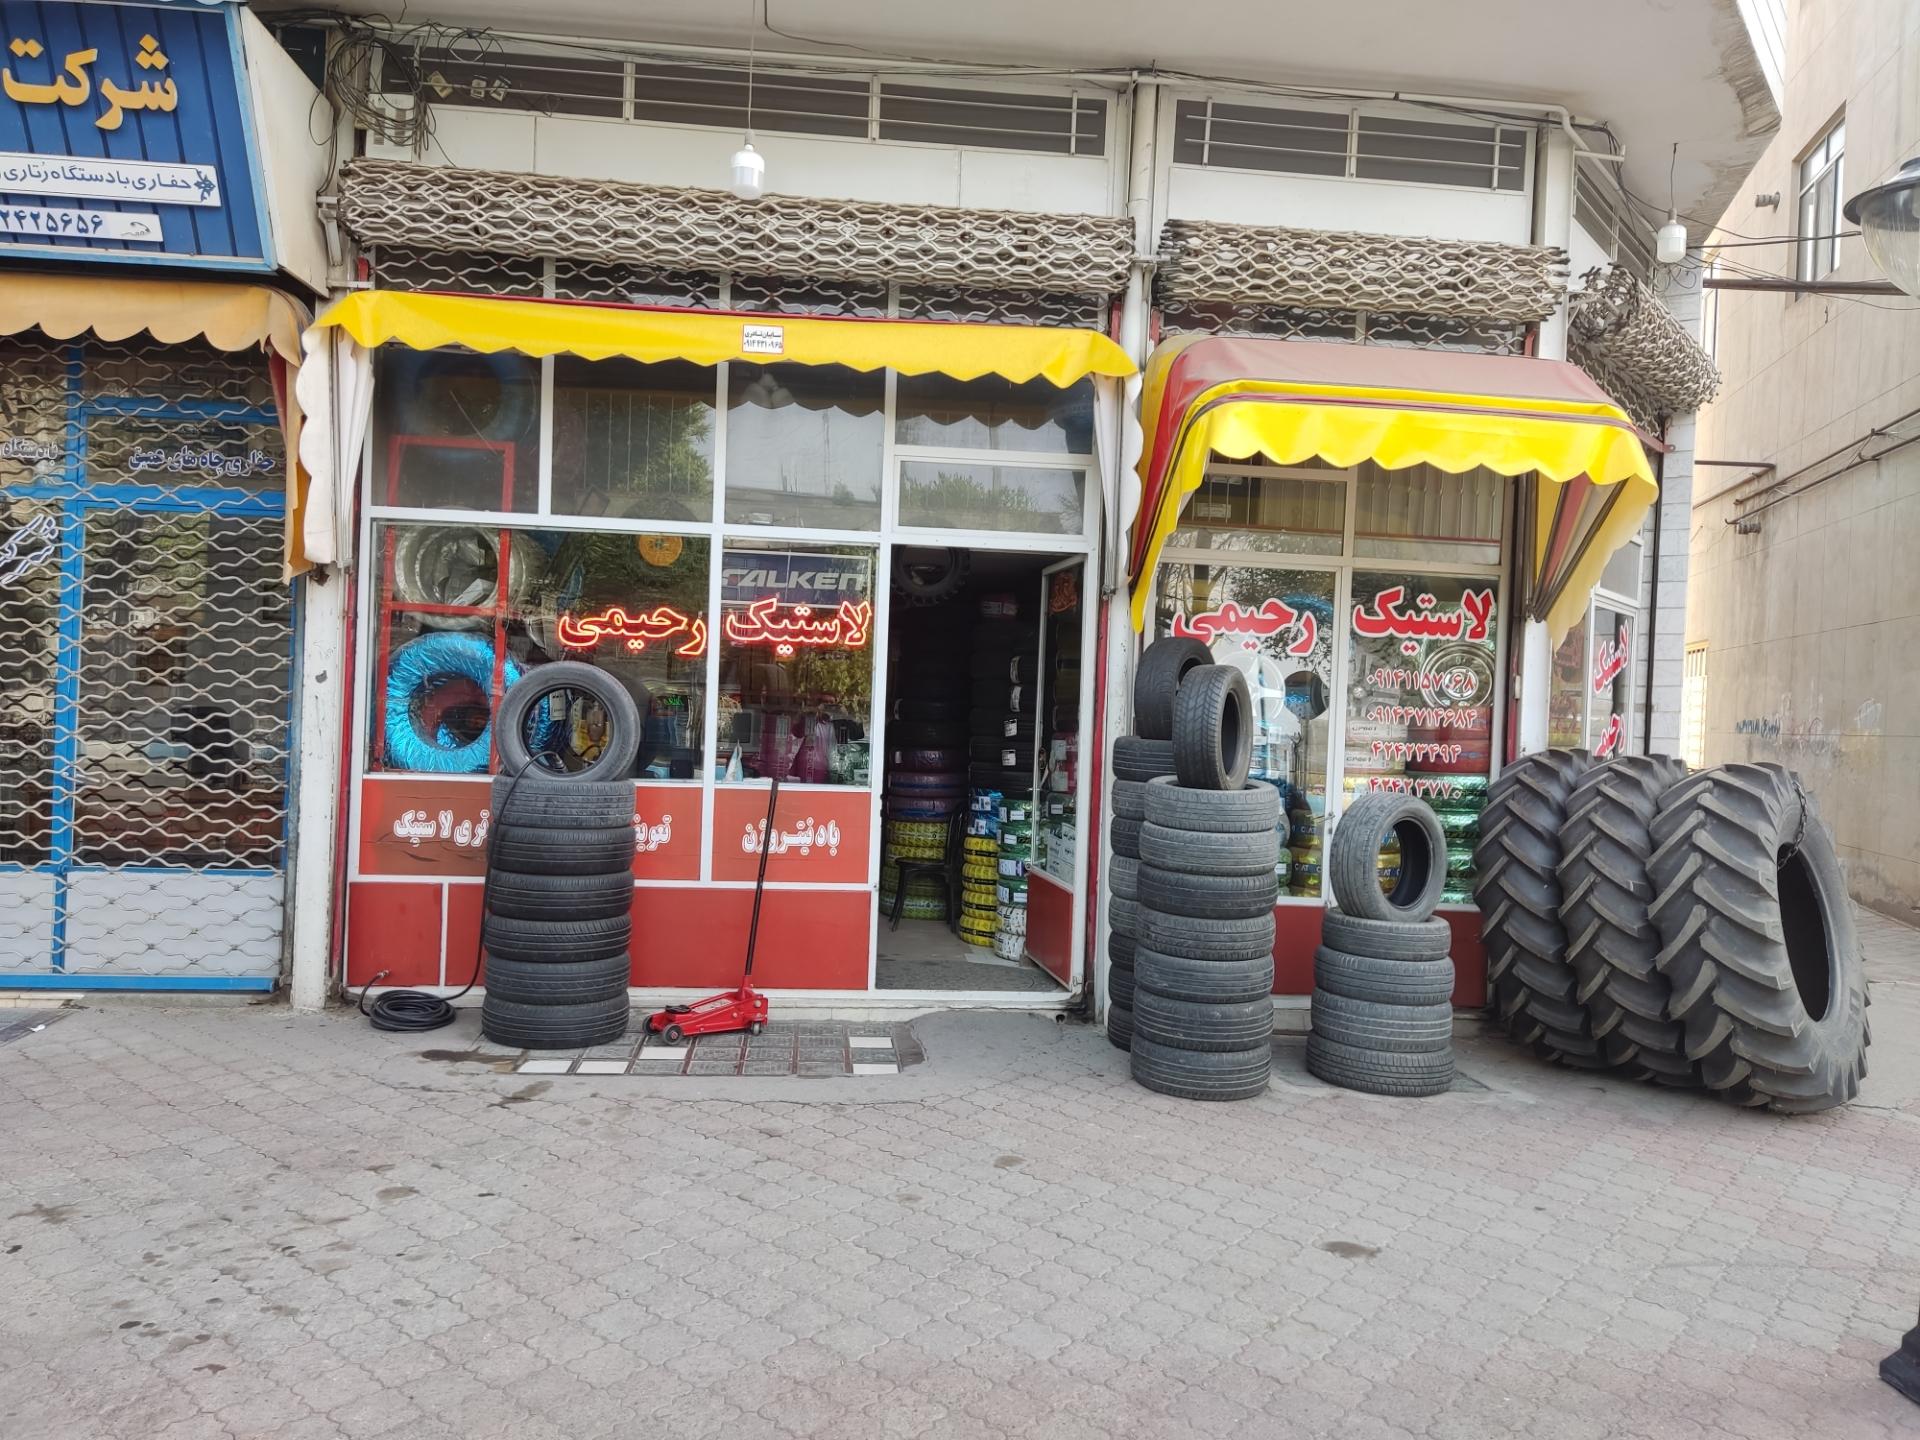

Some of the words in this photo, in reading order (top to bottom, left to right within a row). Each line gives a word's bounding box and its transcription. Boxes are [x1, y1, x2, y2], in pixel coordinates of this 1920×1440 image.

[2, 33, 178, 131] شرکت
[132, 172, 192, 191] حفاری
[558, 605, 708, 656] رحیمی
[726, 597, 873, 656] لاستیک
[1171, 597, 1318, 657] رحیمی
[1353, 584, 1496, 656] لاستیک
